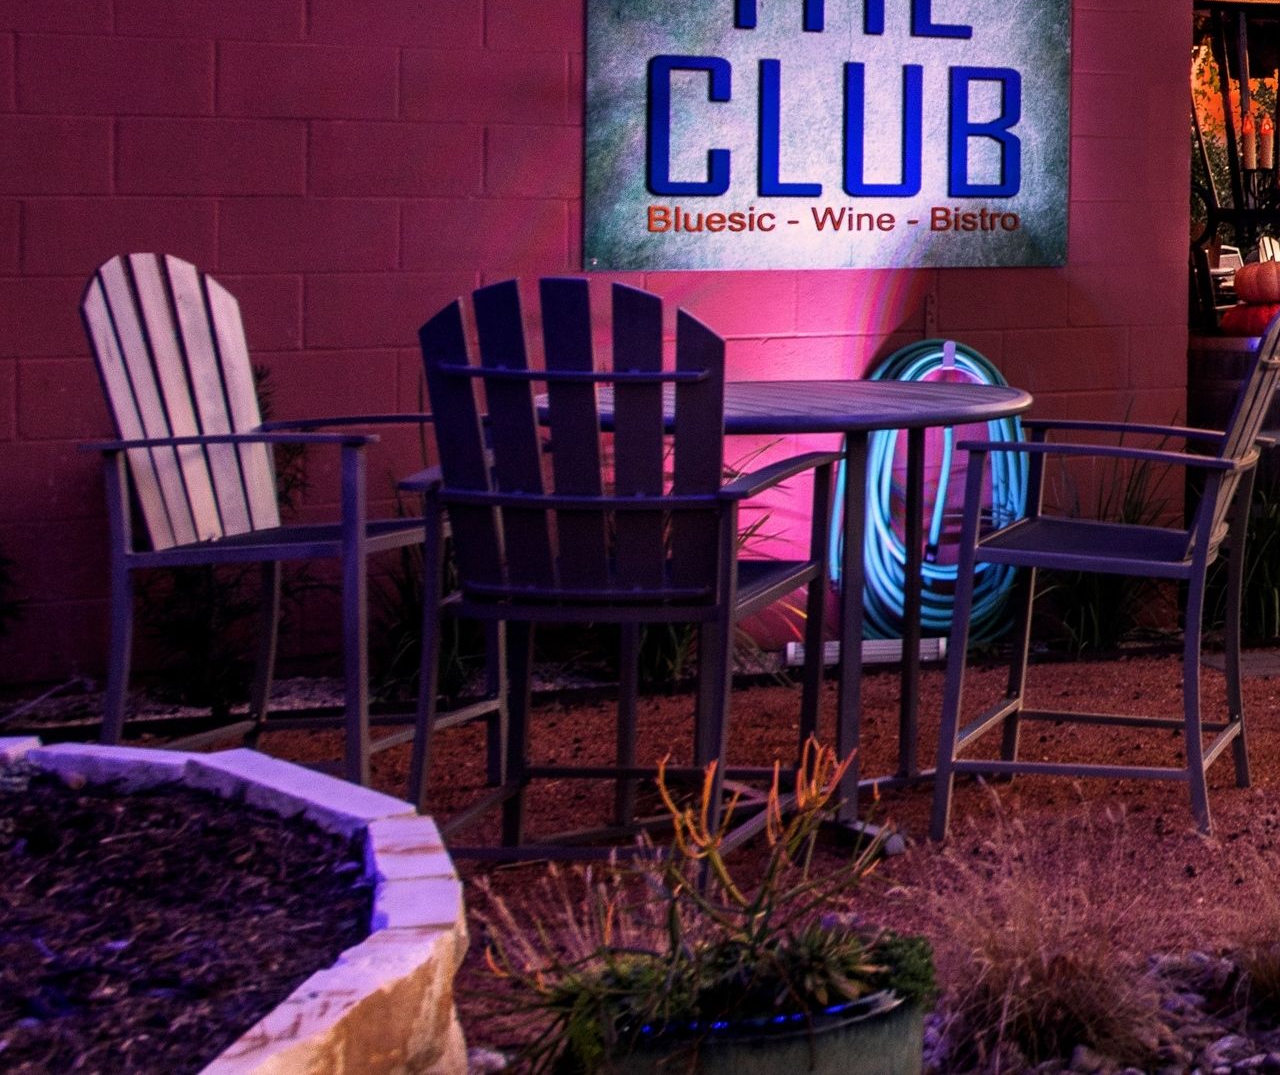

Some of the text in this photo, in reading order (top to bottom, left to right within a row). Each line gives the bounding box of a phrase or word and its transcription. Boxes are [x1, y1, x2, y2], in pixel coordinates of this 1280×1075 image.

[646, 54, 1022, 199] CLUB
[647, 205, 776, 234] Bluesic
[811, 206, 896, 232] Wine
[930, 206, 1020, 233] Bistro
